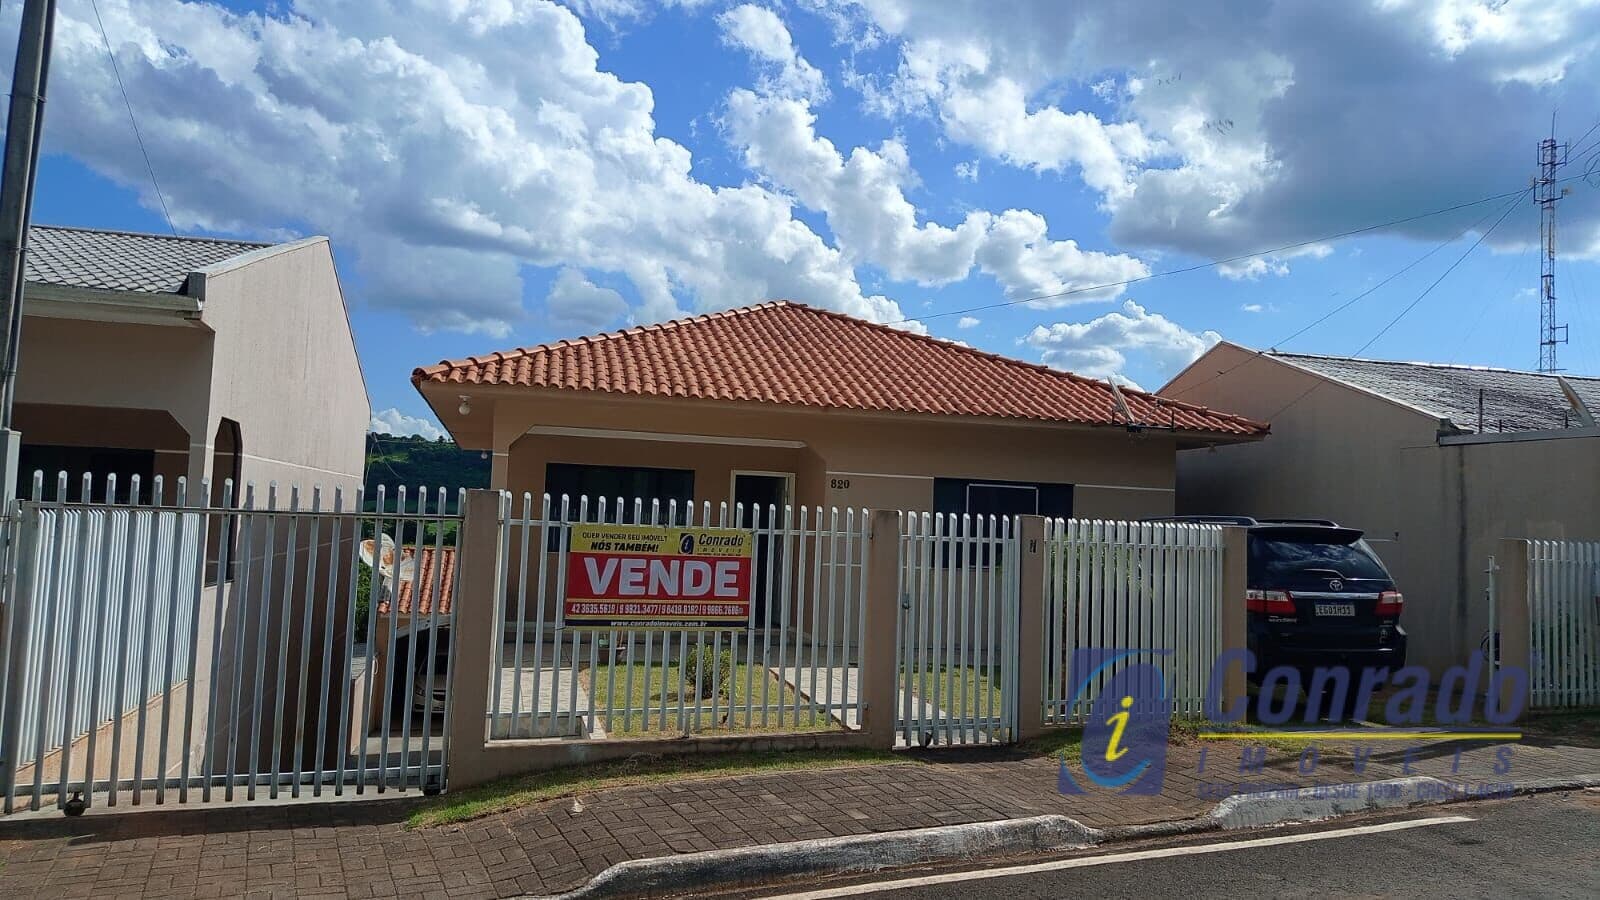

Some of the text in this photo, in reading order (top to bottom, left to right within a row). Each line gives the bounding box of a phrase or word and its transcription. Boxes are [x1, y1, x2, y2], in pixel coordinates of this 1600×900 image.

[831, 479, 850, 489] 820
[627, 533, 640, 541] SEU
[699, 533, 744, 546] Conrado
[591, 540, 659, 552] NÓS TAMBÉM!
[583, 557, 740, 597] VENDE
[571, 603, 580, 613] 42
